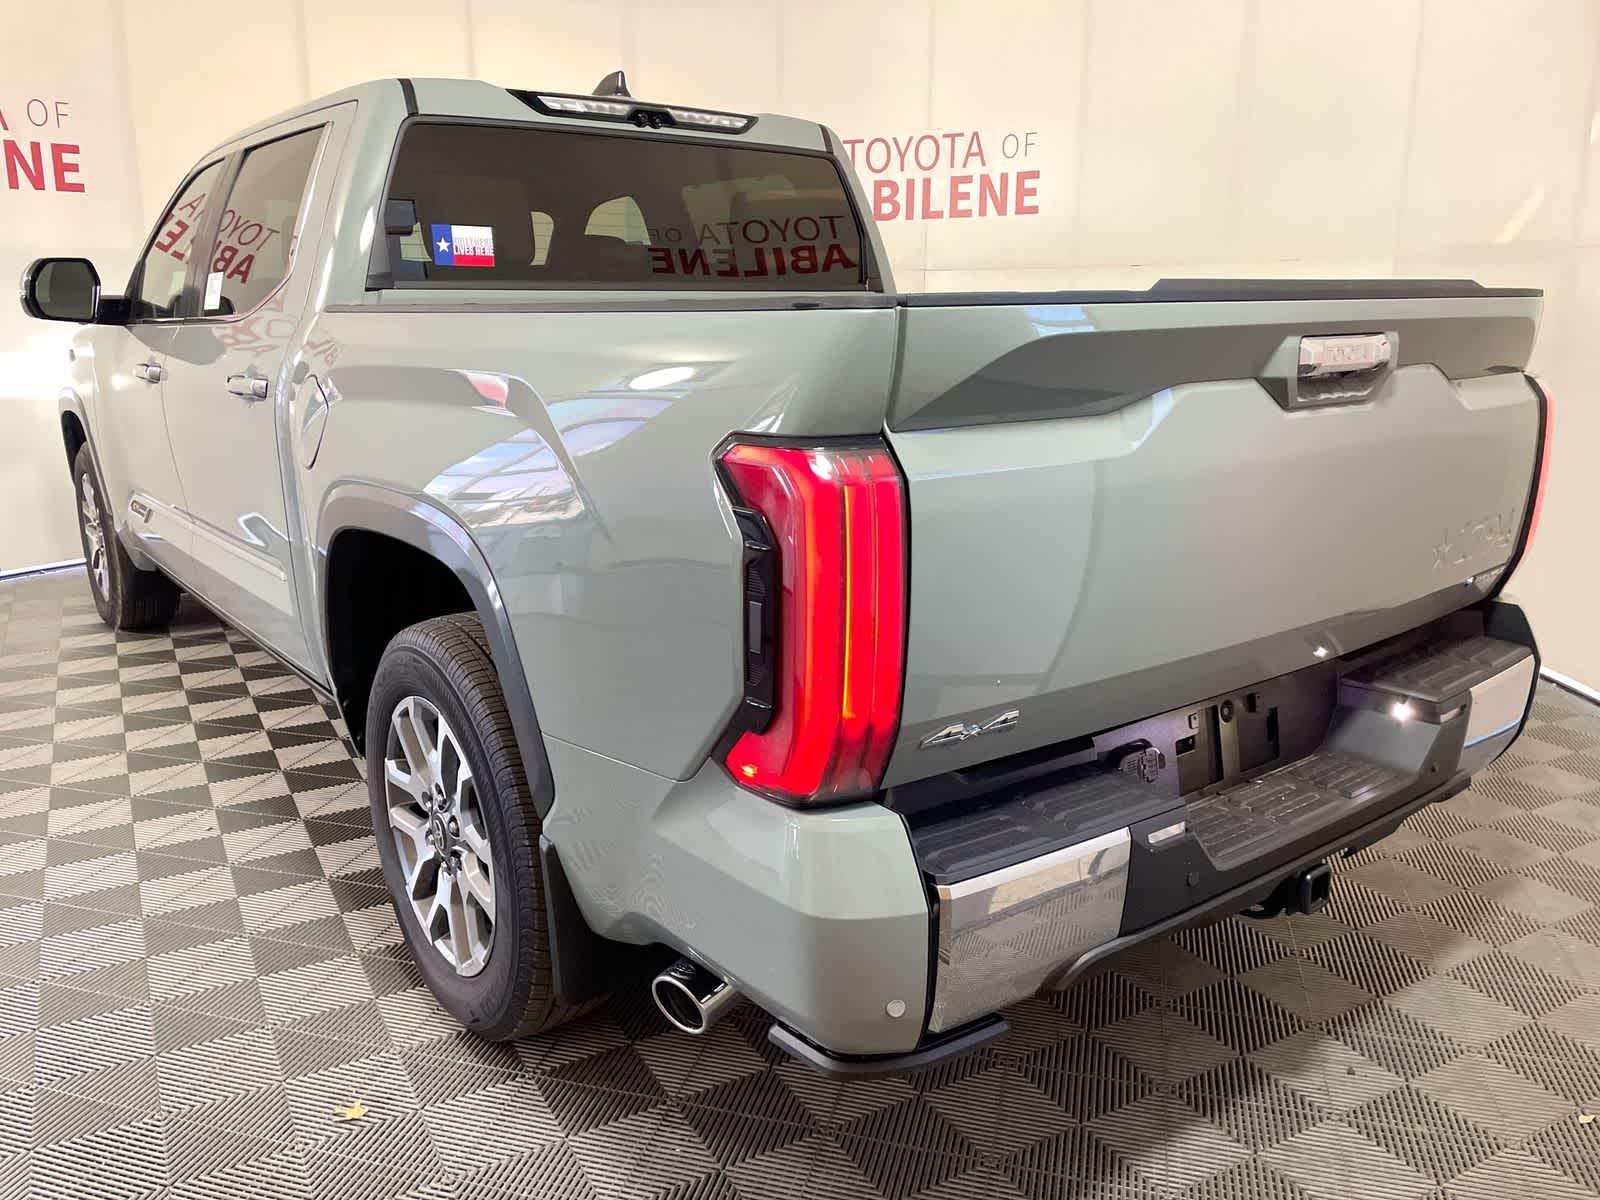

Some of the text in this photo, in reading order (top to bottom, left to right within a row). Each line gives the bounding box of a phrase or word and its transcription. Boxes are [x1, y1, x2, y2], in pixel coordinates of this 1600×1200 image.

[27, 98, 69, 128] OF
[842, 131, 1038, 174] TOYOTA OF
[872, 170, 1041, 222] BILENE
